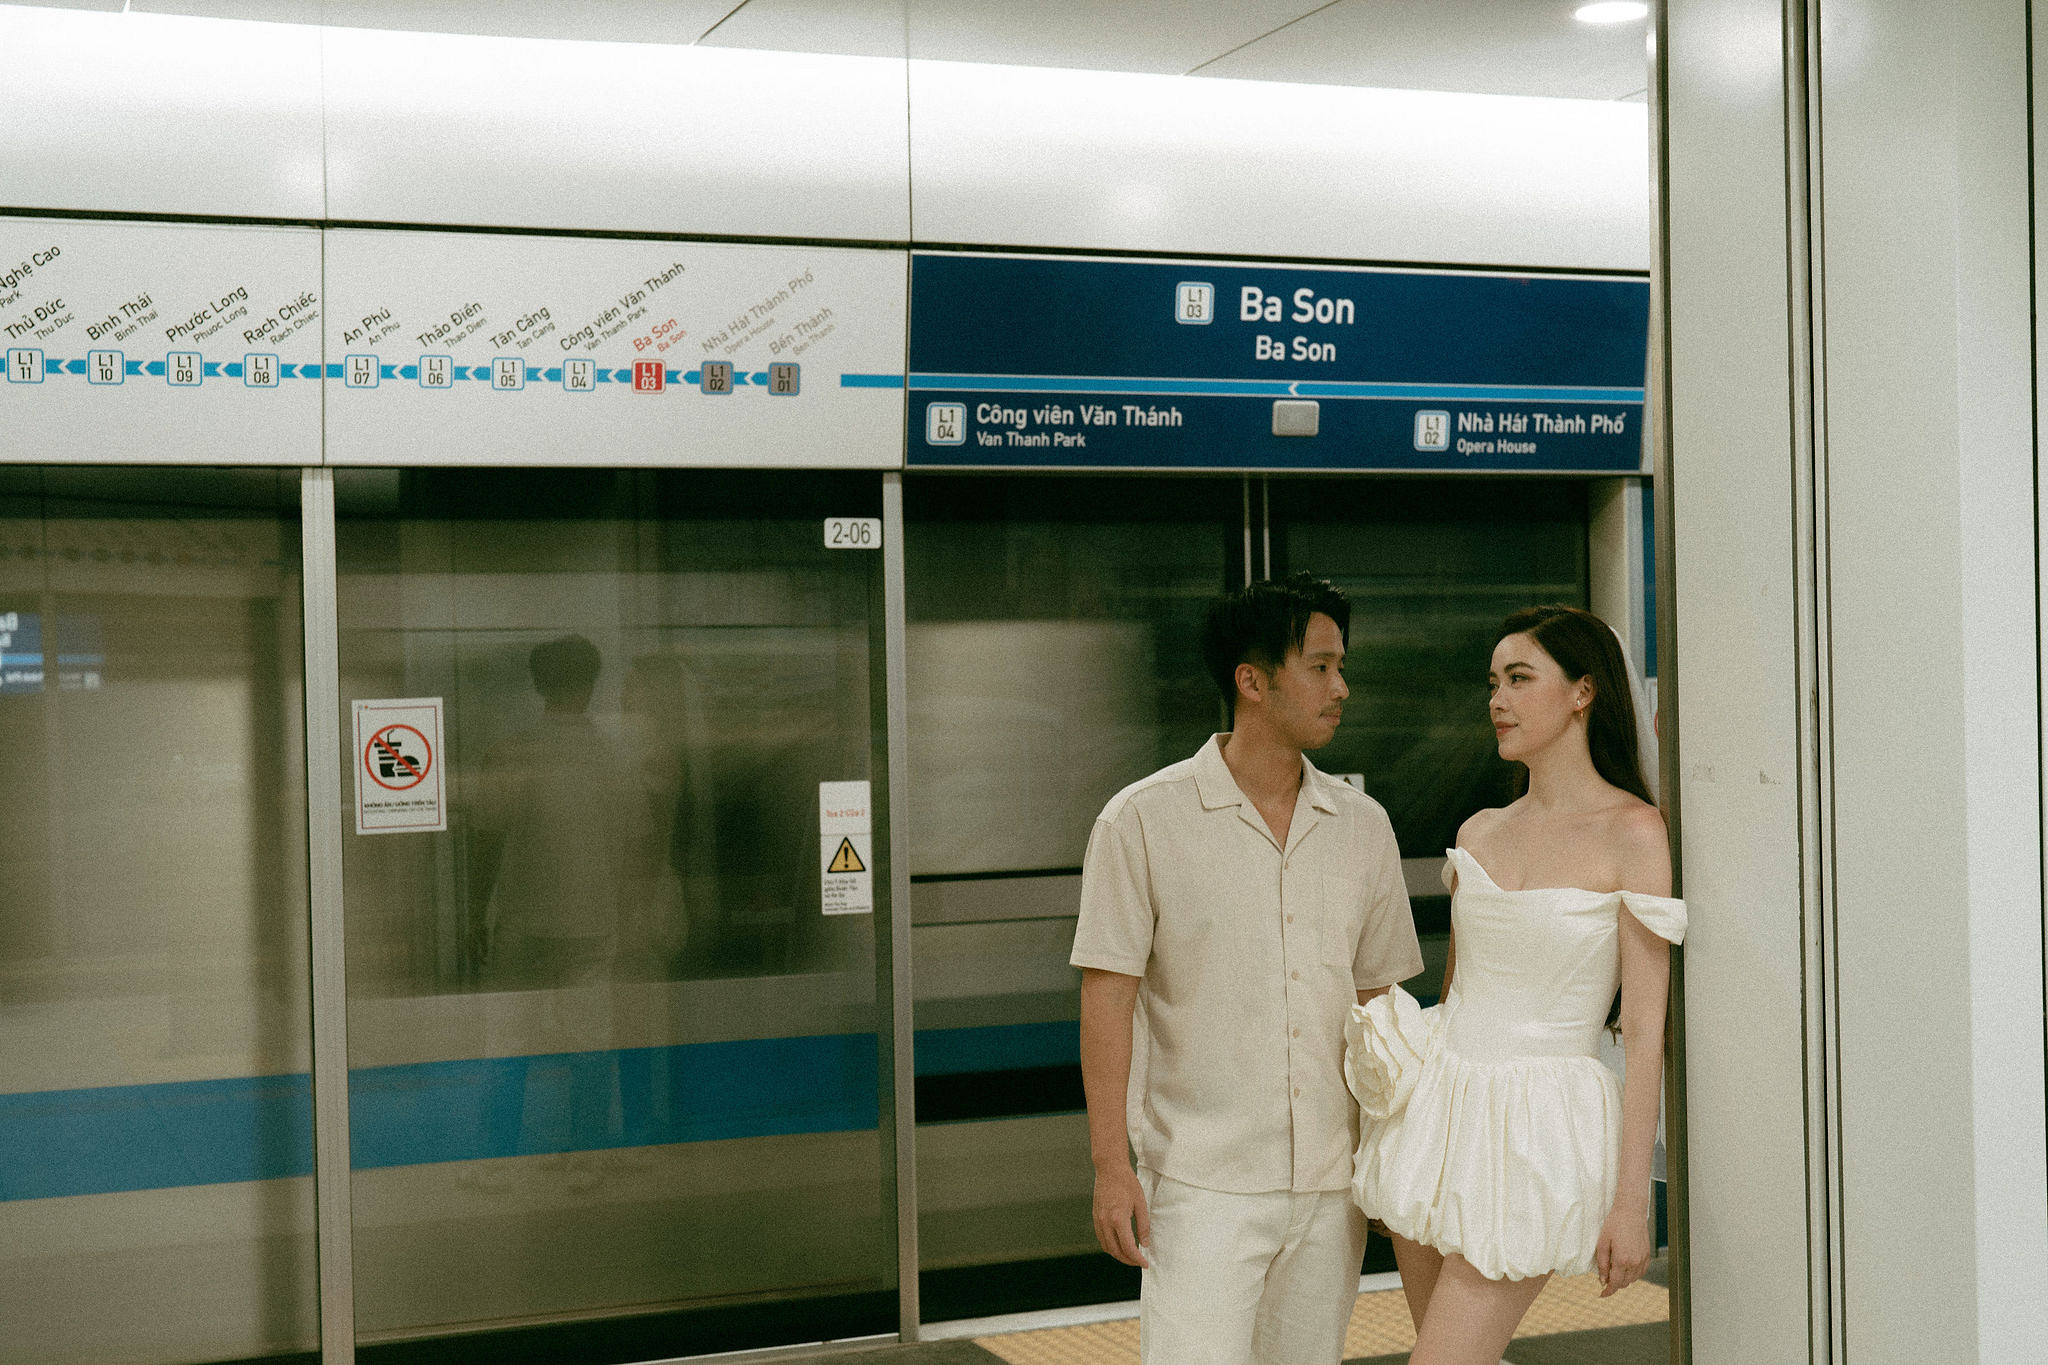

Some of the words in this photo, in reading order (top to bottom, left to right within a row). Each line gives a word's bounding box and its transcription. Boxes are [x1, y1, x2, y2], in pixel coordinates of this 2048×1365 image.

[32, 246, 61, 267] Cao
[0, 290, 23, 308] Park
[1187, 289, 1203, 303] L1
[560, 325, 595, 351] Công
[593, 305, 621, 329] viên
[619, 289, 646, 309] Văn
[644, 262, 685, 292] Thánh
[701, 330, 729, 353] Nhà
[727, 314, 751, 336] Hát
[748, 290, 789, 320] Thành
[788, 267, 814, 294] Phố
[1186, 304, 1202, 318] 03
[1240, 286, 1282, 322] Ba
[1291, 287, 1355, 325] Son
[4, 315, 35, 339] Thủ
[34, 298, 66, 321] Đức
[86, 315, 122, 340] Bình
[120, 292, 153, 317] Thái
[165, 310, 212, 343] Phước
[210, 286, 248, 313] Long
[243, 317, 279, 344] Rạch
[278, 291, 317, 321] Chiếc
[34, 324, 55, 340] Thu
[54, 312, 75, 328] Duc
[114, 324, 137, 342] Binh
[136, 309, 159, 327] Thai
[193, 321, 223, 343] Phuoc
[222, 306, 248, 324] Long
[270, 327, 294, 345] Rach
[293, 310, 319, 329] Chiec
[343, 327, 363, 345] An
[362, 306, 391, 331] Phú
[443, 331, 466, 348] Thao
[465, 316, 487, 335] Dien
[489, 329, 517, 349] Tân
[515, 306, 551, 332] Cảng
[584, 338, 601, 351] Van
[600, 318, 628, 340] Thanh
[627, 305, 648, 323] Park
[768, 332, 796, 355] Bến
[793, 306, 833, 336] Thành
[368, 333, 381, 346] An
[381, 321, 401, 336] Phu
[416, 324, 451, 348] Thảo
[516, 337, 533, 350] Tan
[532, 321, 556, 340] Cang
[633, 335, 653, 352] Ba
[651, 318, 678, 340] Son
[656, 341, 670, 353] Ba
[669, 329, 687, 344] Son
[1255, 335, 1285, 361] Ba
[1291, 336, 1337, 363] Son
[18, 352, 33, 365] L1
[98, 354, 113, 367] L1
[177, 356, 192, 368] L1
[254, 357, 269, 370] L1
[355, 358, 369, 371] L1
[429, 359, 443, 371] L1
[20, 367, 31, 380] 11
[99, 368, 113, 381] 10
[501, 361, 515, 373] L1
[573, 363, 586, 375] L1
[642, 364, 656, 377] L1
[711, 366, 724, 378] L1
[778, 367, 791, 379] L1
[176, 370, 193, 382] 09
[253, 371, 270, 384] 08
[354, 372, 370, 384] 07
[428, 373, 444, 385] 06
[500, 375, 516, 387] 05
[571, 376, 586, 388] 04
[641, 377, 656, 389] 03
[709, 379, 724, 391] 02
[777, 380, 791, 391] 01
[939, 409, 955, 423] L1
[976, 402, 1028, 430] Công
[1033, 404, 1075, 426] viên
[1079, 405, 1117, 426] Văn
[1122, 405, 1183, 427] Thánh
[1426, 417, 1440, 430] L1
[1458, 412, 1494, 433] Nhà
[1498, 413, 1529, 434] Hát
[1532, 413, 1586, 434] Thành
[1590, 411, 1627, 434] Phố
[937, 425, 955, 439] 04
[976, 432, 1003, 447] Van
[1006, 432, 1050, 447] Thanh
[1054, 432, 1086, 448] Park
[1424, 432, 1440, 445] 02
[1457, 440, 1494, 456] Opera
[1497, 440, 1537, 454] House
[833, 522, 871, 544] 2-06
